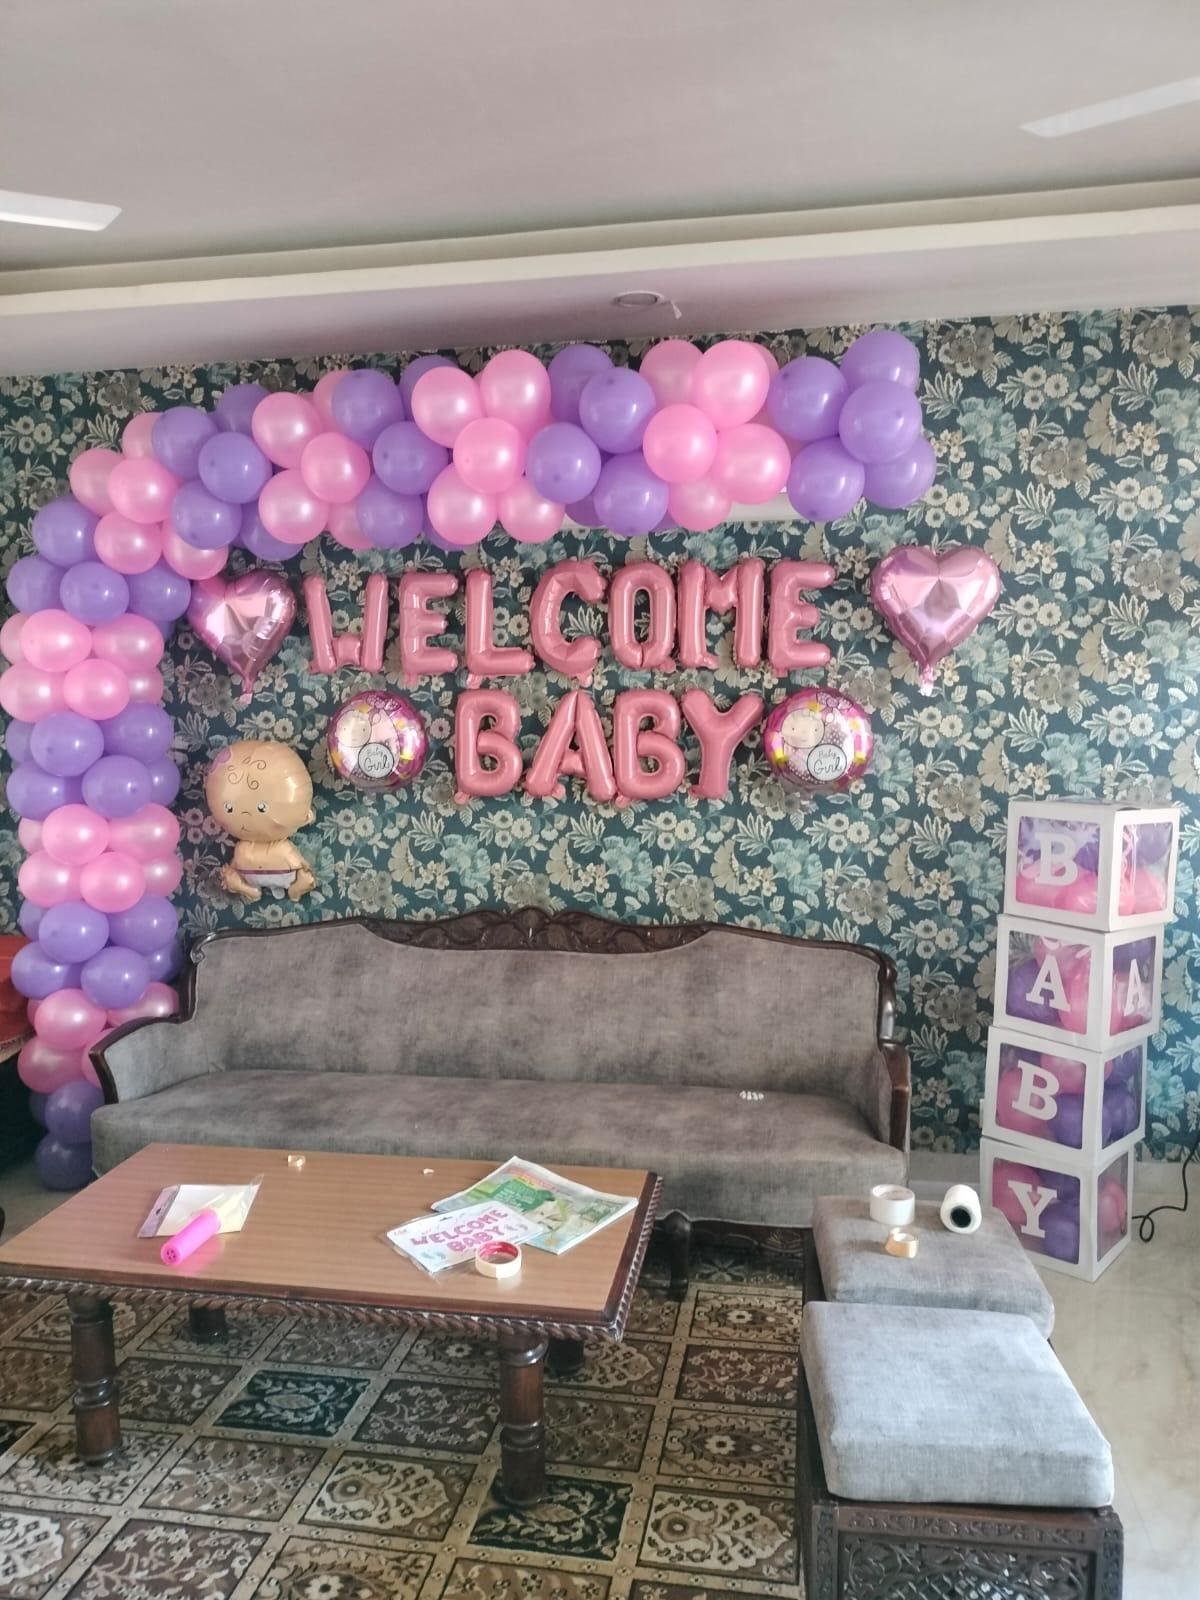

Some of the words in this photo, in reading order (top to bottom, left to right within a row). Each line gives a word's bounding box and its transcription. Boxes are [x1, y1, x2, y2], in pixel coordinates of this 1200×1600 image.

[303, 557, 836, 685] WELCOME
[454, 688, 765, 805] BABY
[410, 1209, 508, 1245] WELCOME
[446, 1226, 504, 1252] BABY
